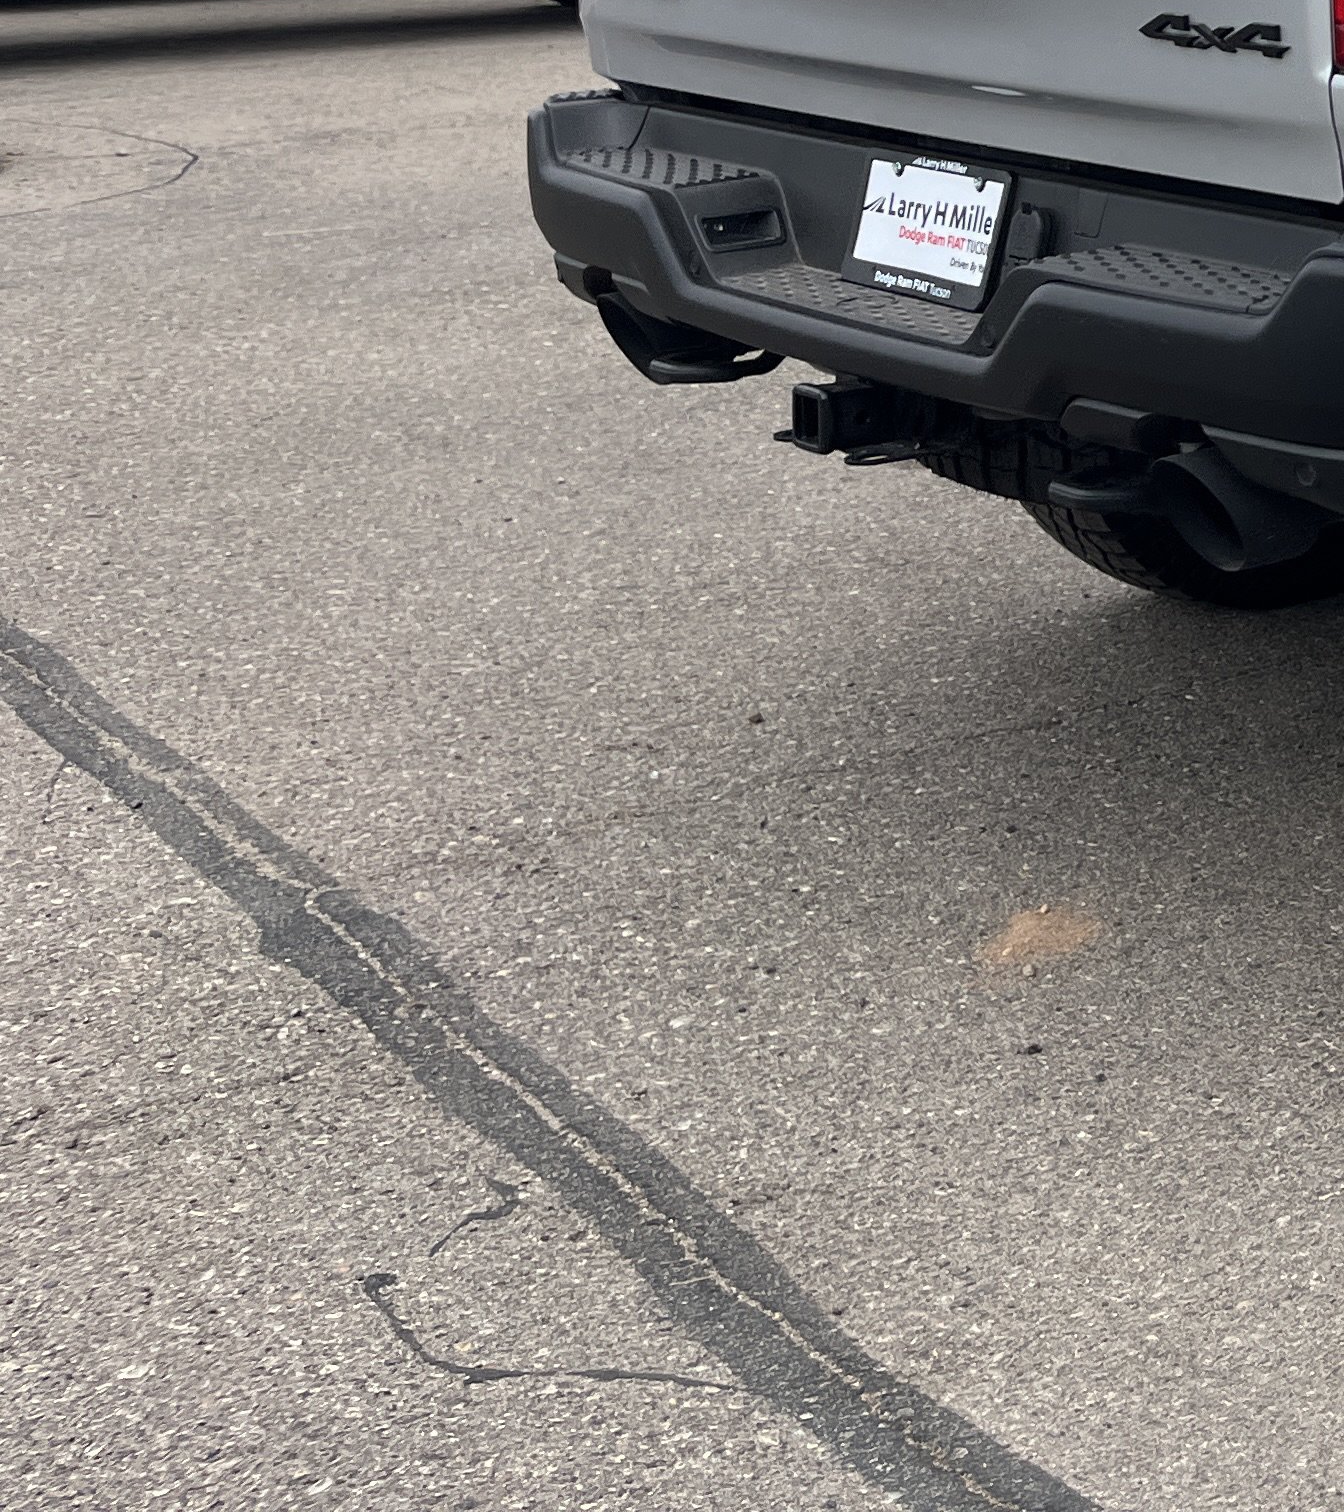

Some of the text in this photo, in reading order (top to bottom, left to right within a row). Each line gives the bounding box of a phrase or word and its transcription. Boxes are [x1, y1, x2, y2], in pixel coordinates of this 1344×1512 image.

[922, 156, 940, 171] Larry
[888, 192, 993, 236] Larry H Mille
[899, 225, 926, 245] Dodge
[927, 231, 945, 246] Ram
[947, 235, 966, 251] FIAT
[874, 270, 951, 299] Dodge Ram FIAT Tucson
